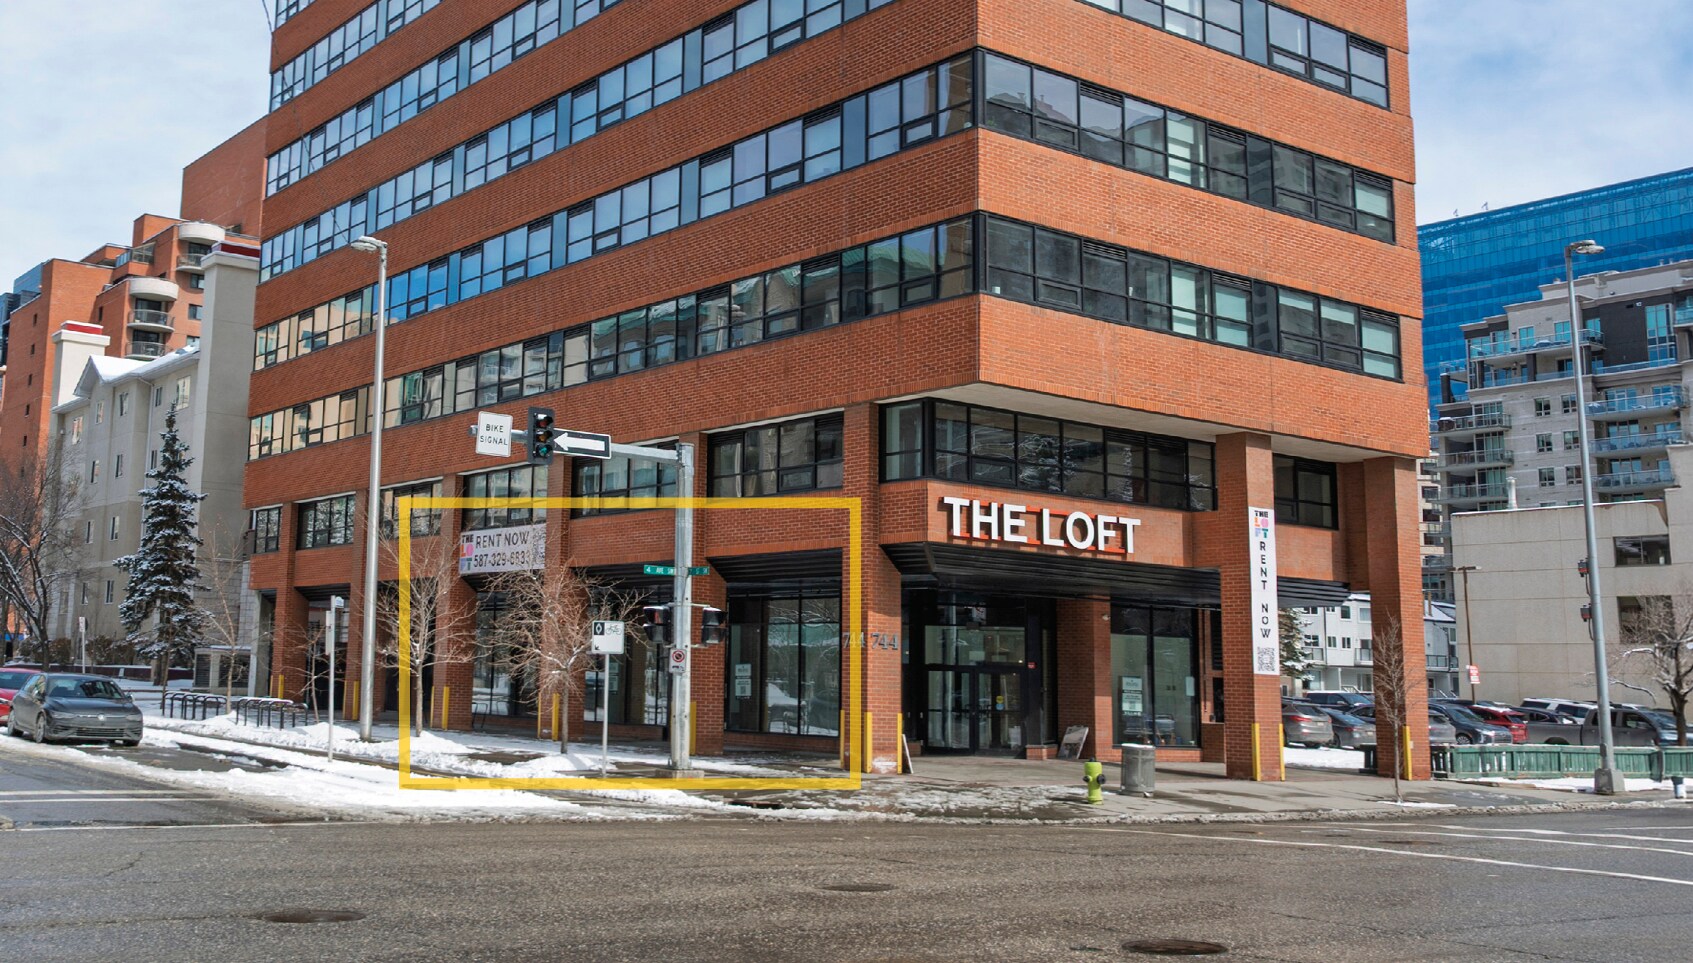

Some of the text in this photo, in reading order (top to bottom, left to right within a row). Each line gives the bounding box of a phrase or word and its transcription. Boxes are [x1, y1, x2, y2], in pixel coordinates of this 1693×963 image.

[486, 424, 503, 432] BIKE
[480, 435, 508, 445] SIGNAL
[1254, 510, 1269, 518] THE
[943, 496, 1141, 553] THE LOFT
[462, 534, 474, 543] THE
[476, 531, 529, 549] RENT NOW
[1259, 541, 1271, 639] RENT NOW
[871, 631, 899, 650] 744
